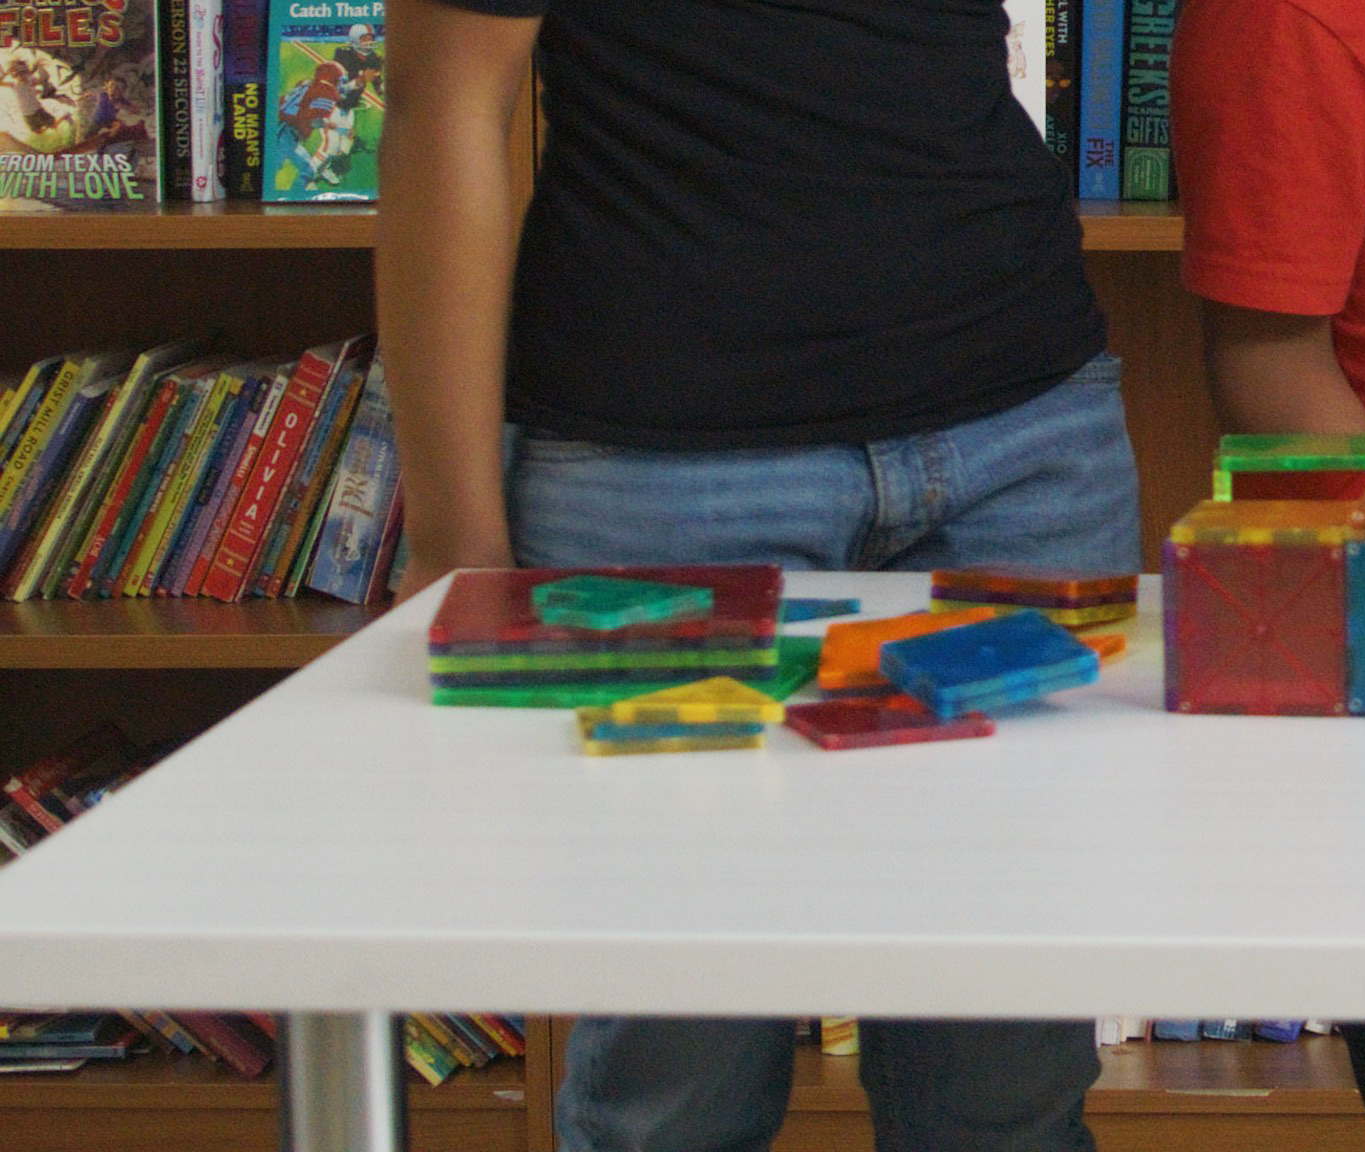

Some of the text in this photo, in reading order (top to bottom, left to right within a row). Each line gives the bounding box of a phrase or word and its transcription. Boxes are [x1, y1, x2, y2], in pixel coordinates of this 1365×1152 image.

[289, 2, 332, 18] Catch
[335, 2, 370, 17] That
[1045, 26, 1055, 57] EYES
[1056, 10, 1068, 44] WITH
[174, 57, 187, 75] 22
[174, 78, 190, 158] SECONDS
[233, 93, 246, 140] LAND
[245, 83, 260, 167] NO MAN'S
[1127, 115, 1169, 146] GIFTS
[1056, 132, 1068, 154] XIO
[1086, 137, 1104, 169] FIX
[1104, 141, 1115, 167] THE
[0, 153, 132, 172] FROM TEXAS
[69, 172, 144, 199] LOVE
[11, 369, 74, 471] GRIST MILL ROAD
[245, 412, 299, 521] OLIVIA
